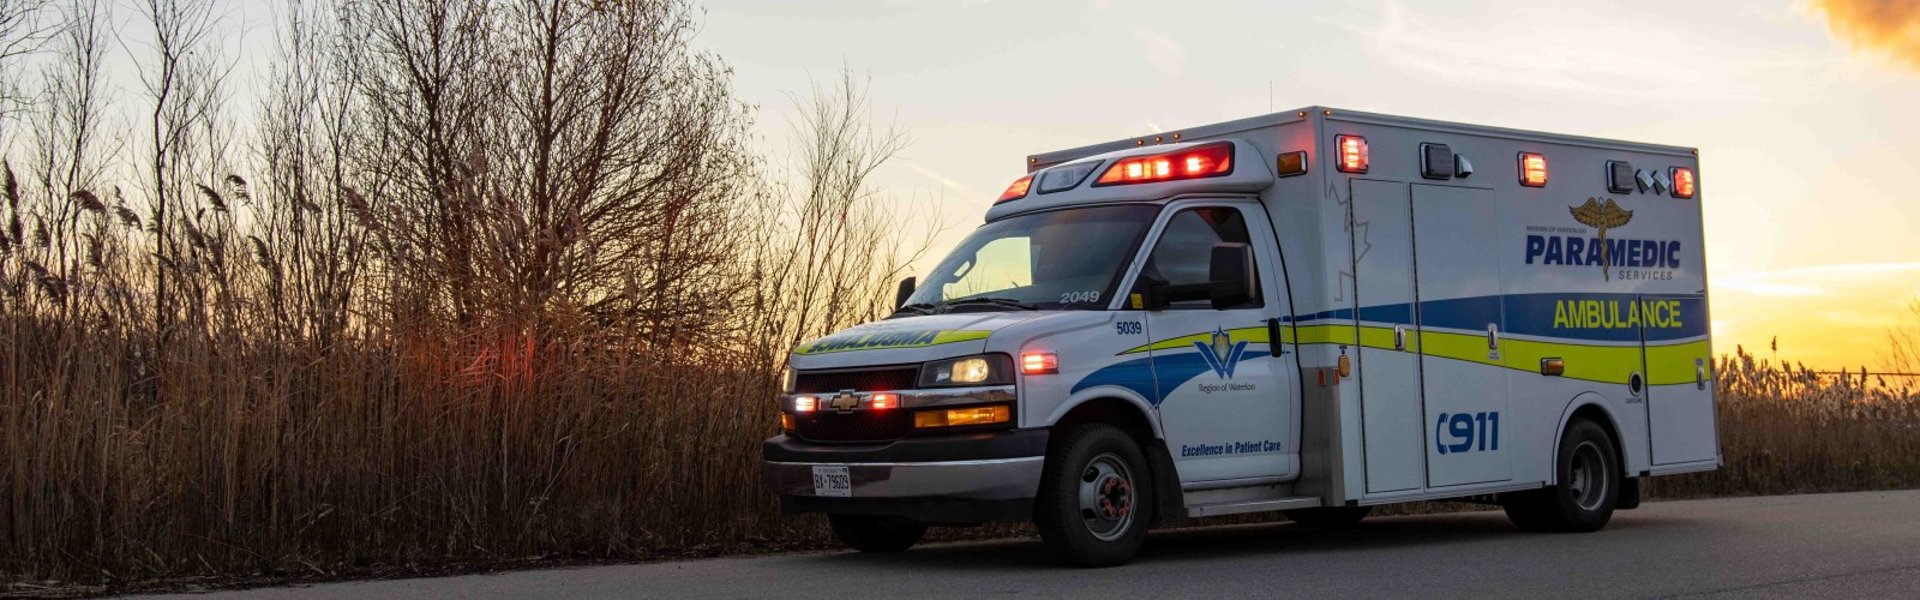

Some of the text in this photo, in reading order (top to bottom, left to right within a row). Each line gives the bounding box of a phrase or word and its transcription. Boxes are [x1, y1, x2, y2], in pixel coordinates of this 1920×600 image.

[1525, 235, 1681, 268] PARAMEDIC
[1618, 270, 1673, 281] SERVICES
[1059, 290, 1100, 304] 2049
[1553, 299, 1682, 329] AMBULANCE
[1116, 321, 1142, 335] 5039
[1198, 382, 1256, 394] Region of Waterloo
[1448, 411, 1499, 453] 911
[1182, 440, 1281, 457] Excellence in Patient Care
